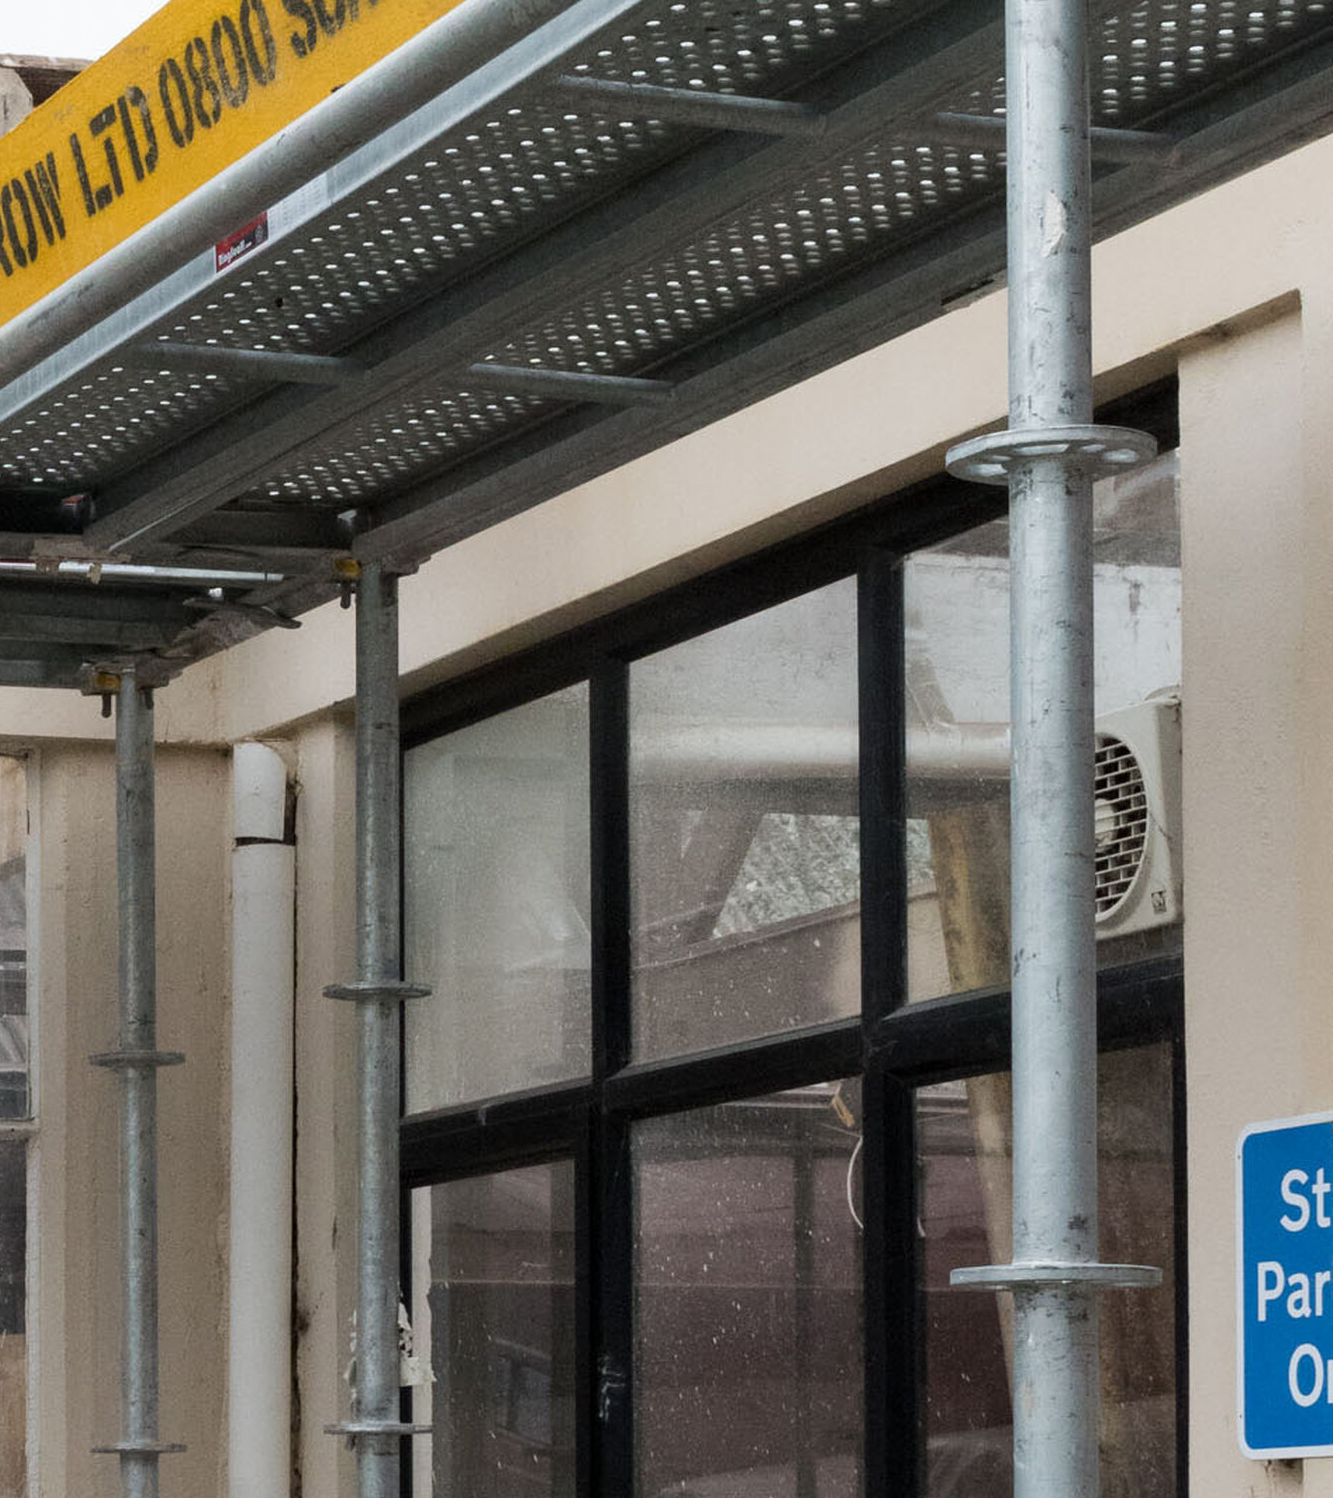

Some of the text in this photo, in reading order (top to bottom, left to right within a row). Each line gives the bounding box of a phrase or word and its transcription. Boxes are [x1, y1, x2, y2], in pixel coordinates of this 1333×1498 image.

[69, 85, 159, 218] LTD
[1279, 1166, 1332, 1233] St
[1256, 1260, 1332, 1323] Par
[1288, 1342, 1333, 1408] O
